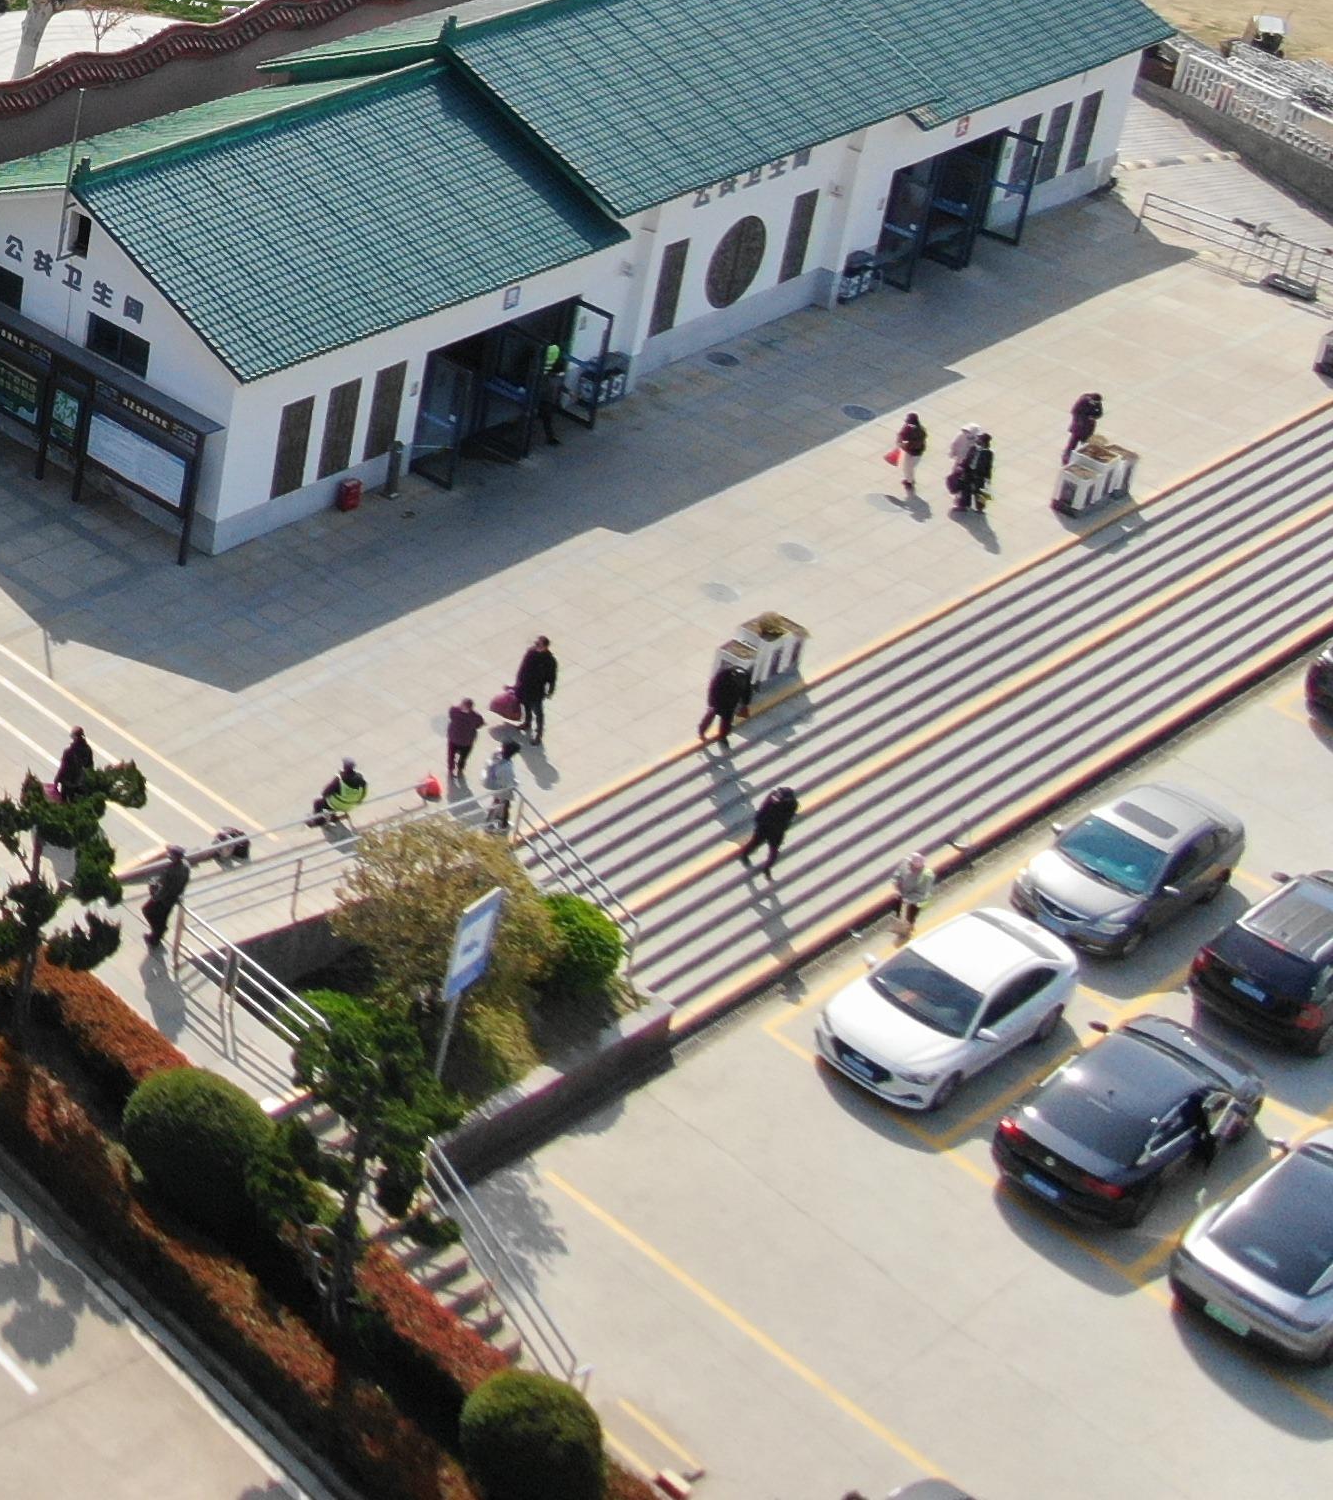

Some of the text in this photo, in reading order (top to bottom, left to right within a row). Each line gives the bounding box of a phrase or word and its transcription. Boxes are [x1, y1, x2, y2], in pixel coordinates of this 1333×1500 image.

[4, 234, 144, 324] 公共卫生间
